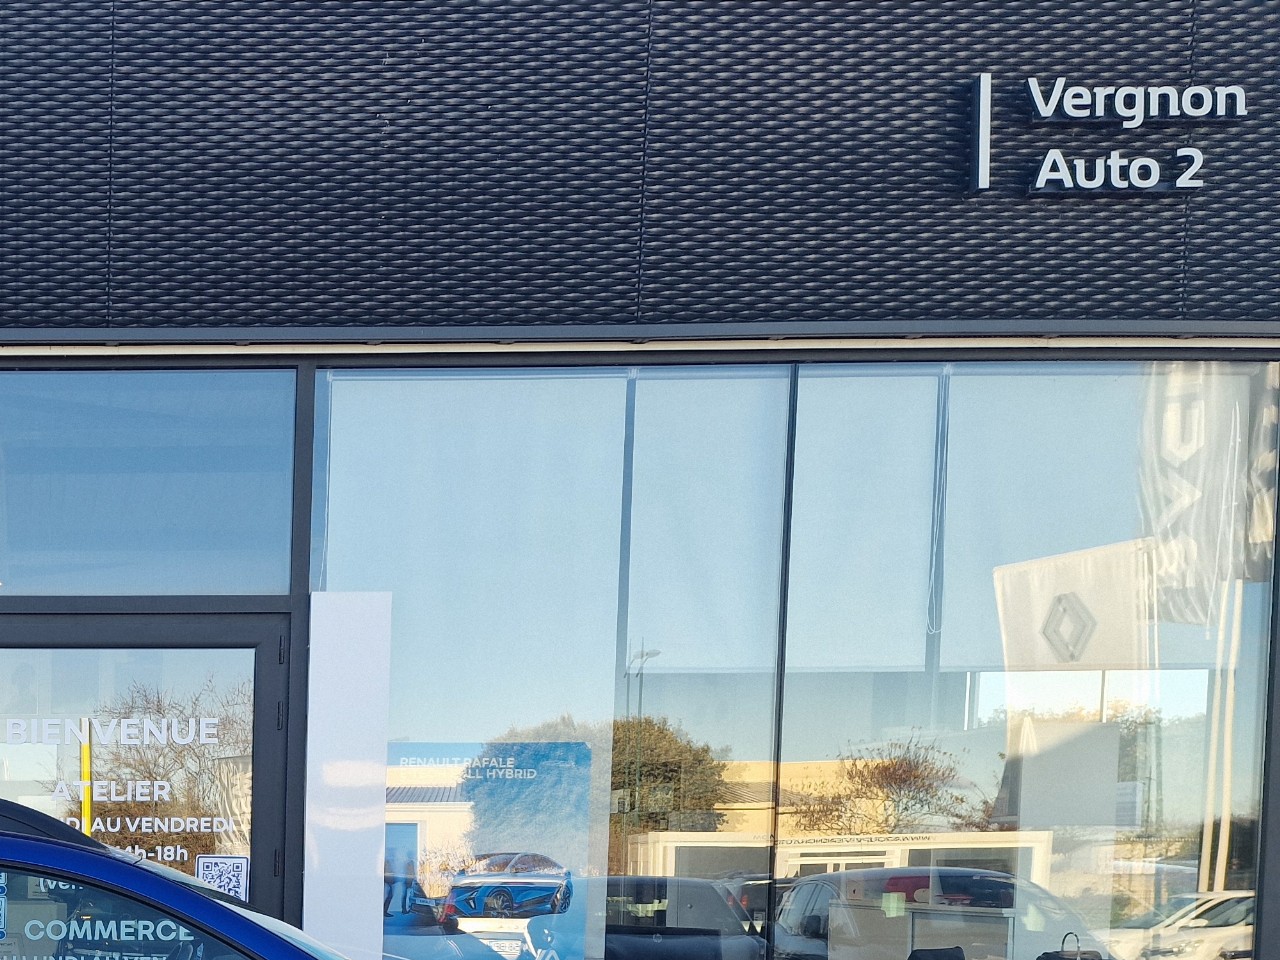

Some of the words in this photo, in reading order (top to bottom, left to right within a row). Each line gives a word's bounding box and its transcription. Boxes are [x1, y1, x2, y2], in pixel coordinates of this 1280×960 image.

[1027, 77, 1248, 129] Vergnon
[1035, 149, 1161, 189] Auto
[1175, 148, 1204, 188] 2
[6, 717, 219, 745] BIENVENUE
[399, 757, 463, 767] RENAULT
[463, 757, 515, 768] RAFALE
[486, 768, 537, 779] HYBRID
[51, 780, 171, 802] ATELIER
[91, 817, 121, 833] AU
[125, 817, 234, 833] VENDREDI
[24, 919, 195, 941] COMMERCE
